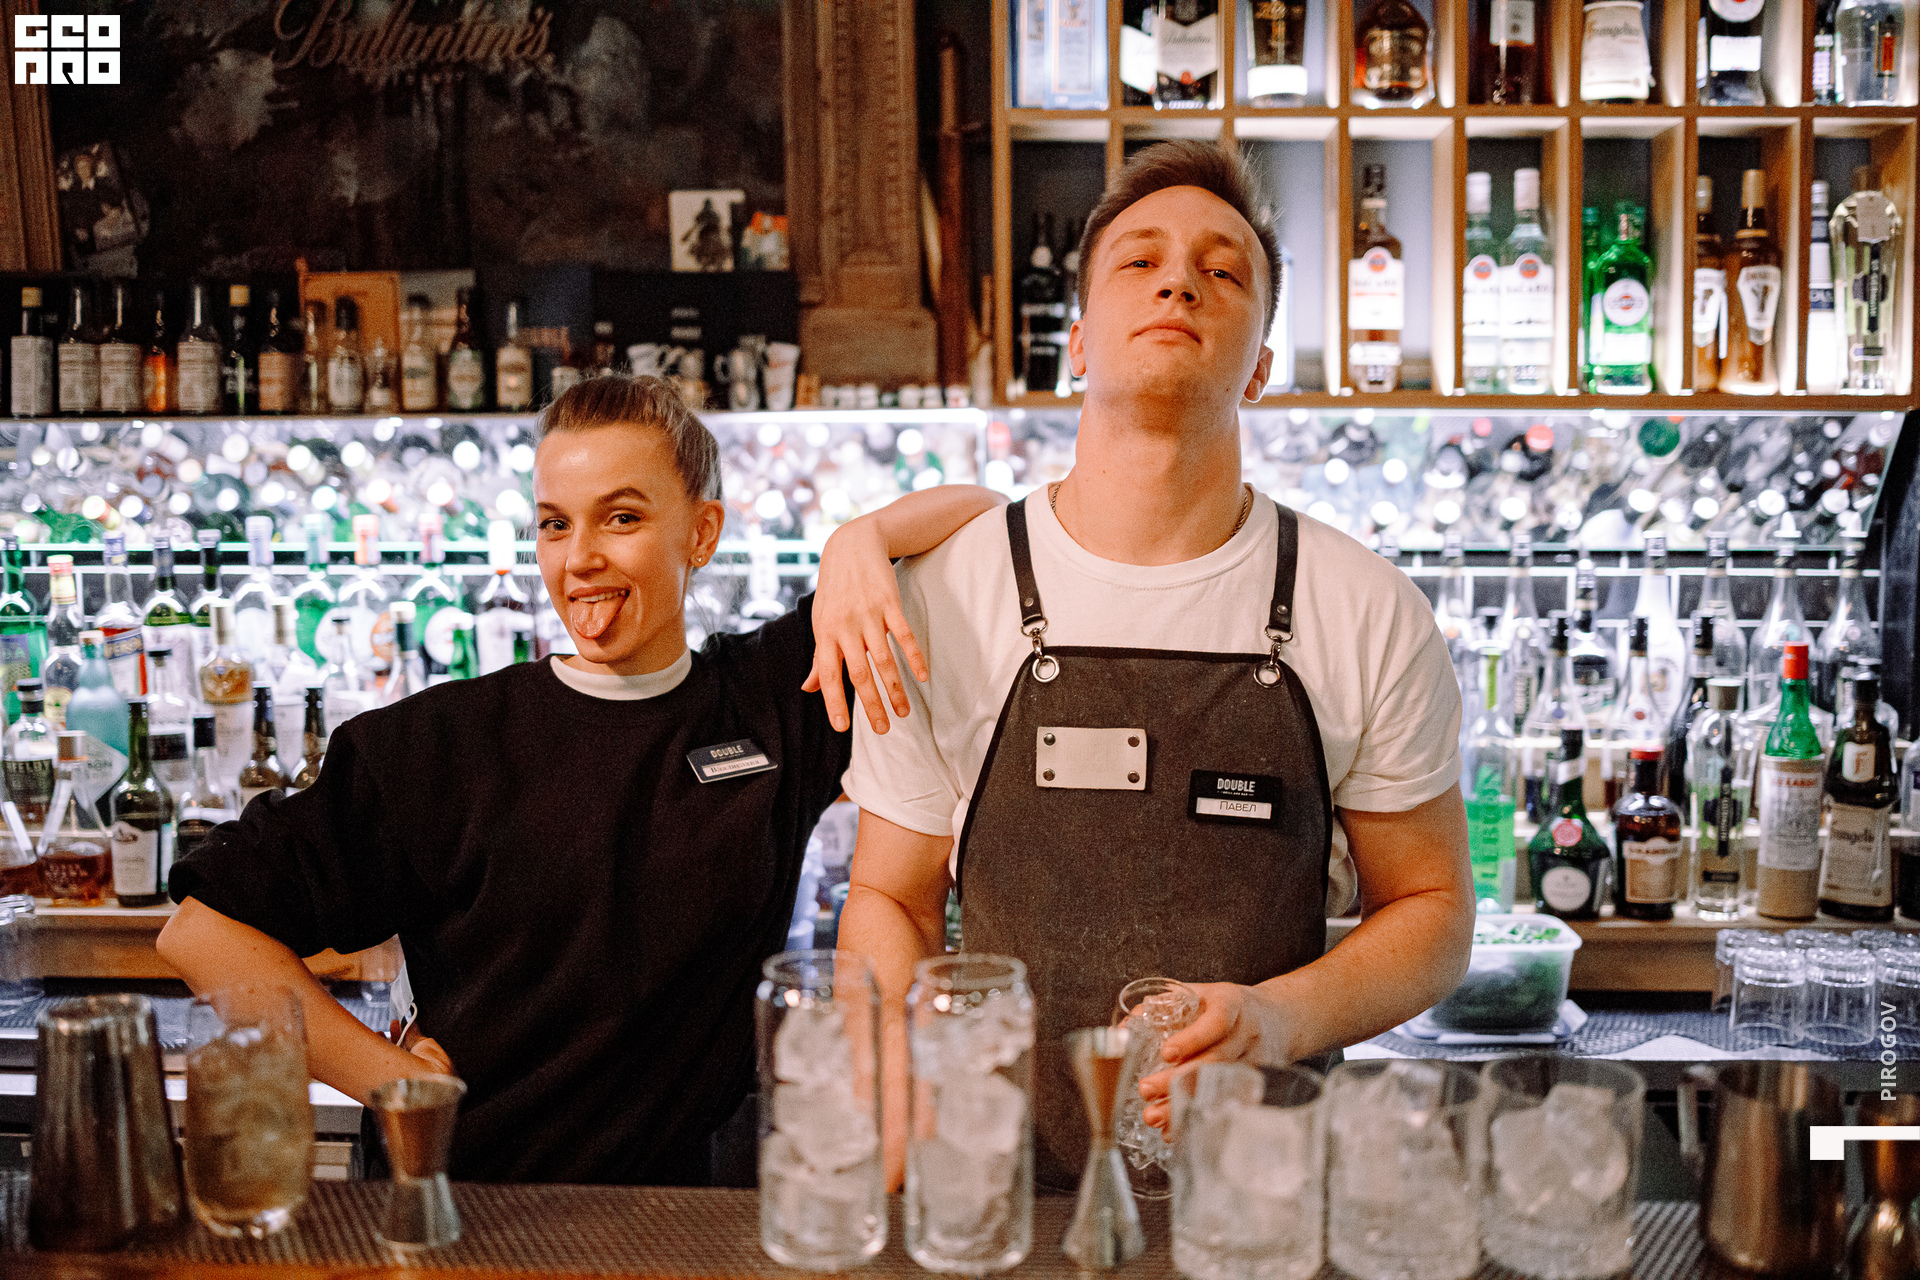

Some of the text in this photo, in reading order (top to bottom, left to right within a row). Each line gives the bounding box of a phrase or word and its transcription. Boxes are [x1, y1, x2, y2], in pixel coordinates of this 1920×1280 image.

[710, 745, 744, 758] DOUBLE
[1217, 778, 1256, 792] DOUBLE
[1220, 801, 1257, 812] ПАВЕЛ
